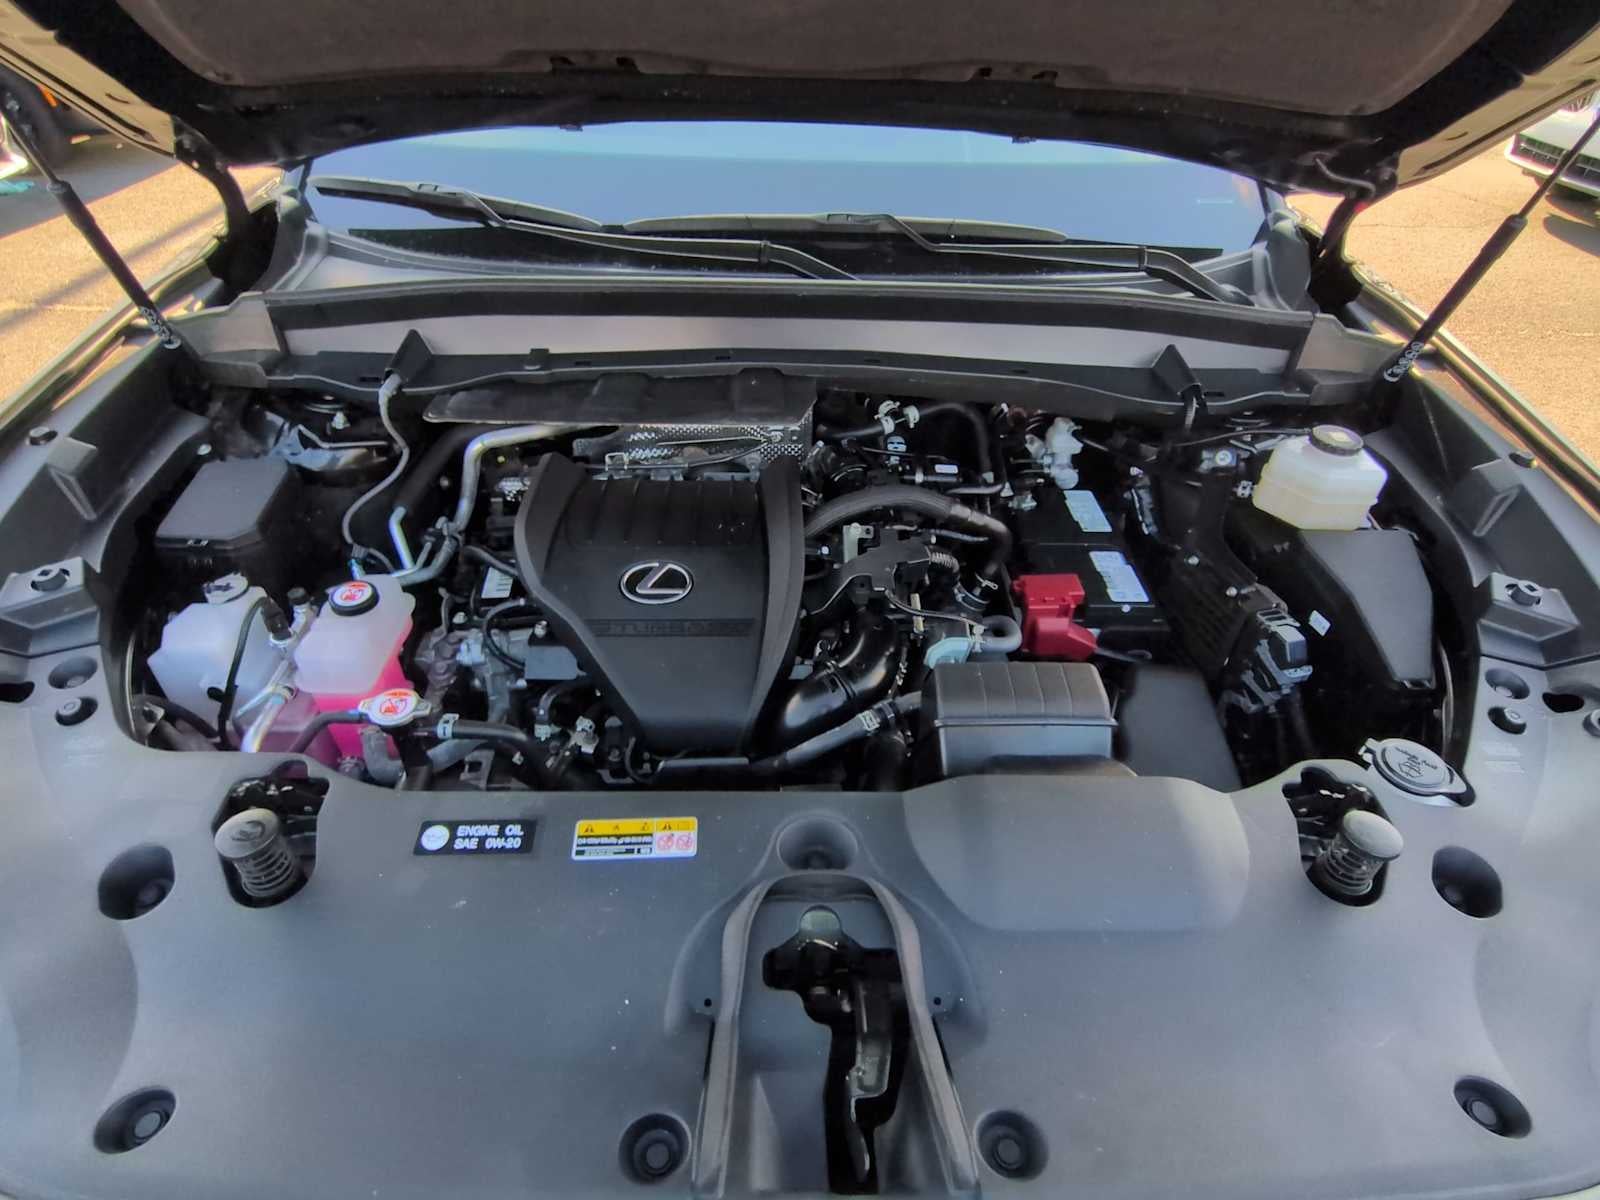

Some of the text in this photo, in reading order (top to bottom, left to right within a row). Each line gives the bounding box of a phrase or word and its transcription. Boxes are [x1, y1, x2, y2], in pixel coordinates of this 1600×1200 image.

[457, 824, 524, 836] ENGINE OIL
[454, 837, 522, 850] SAE 0W-20
